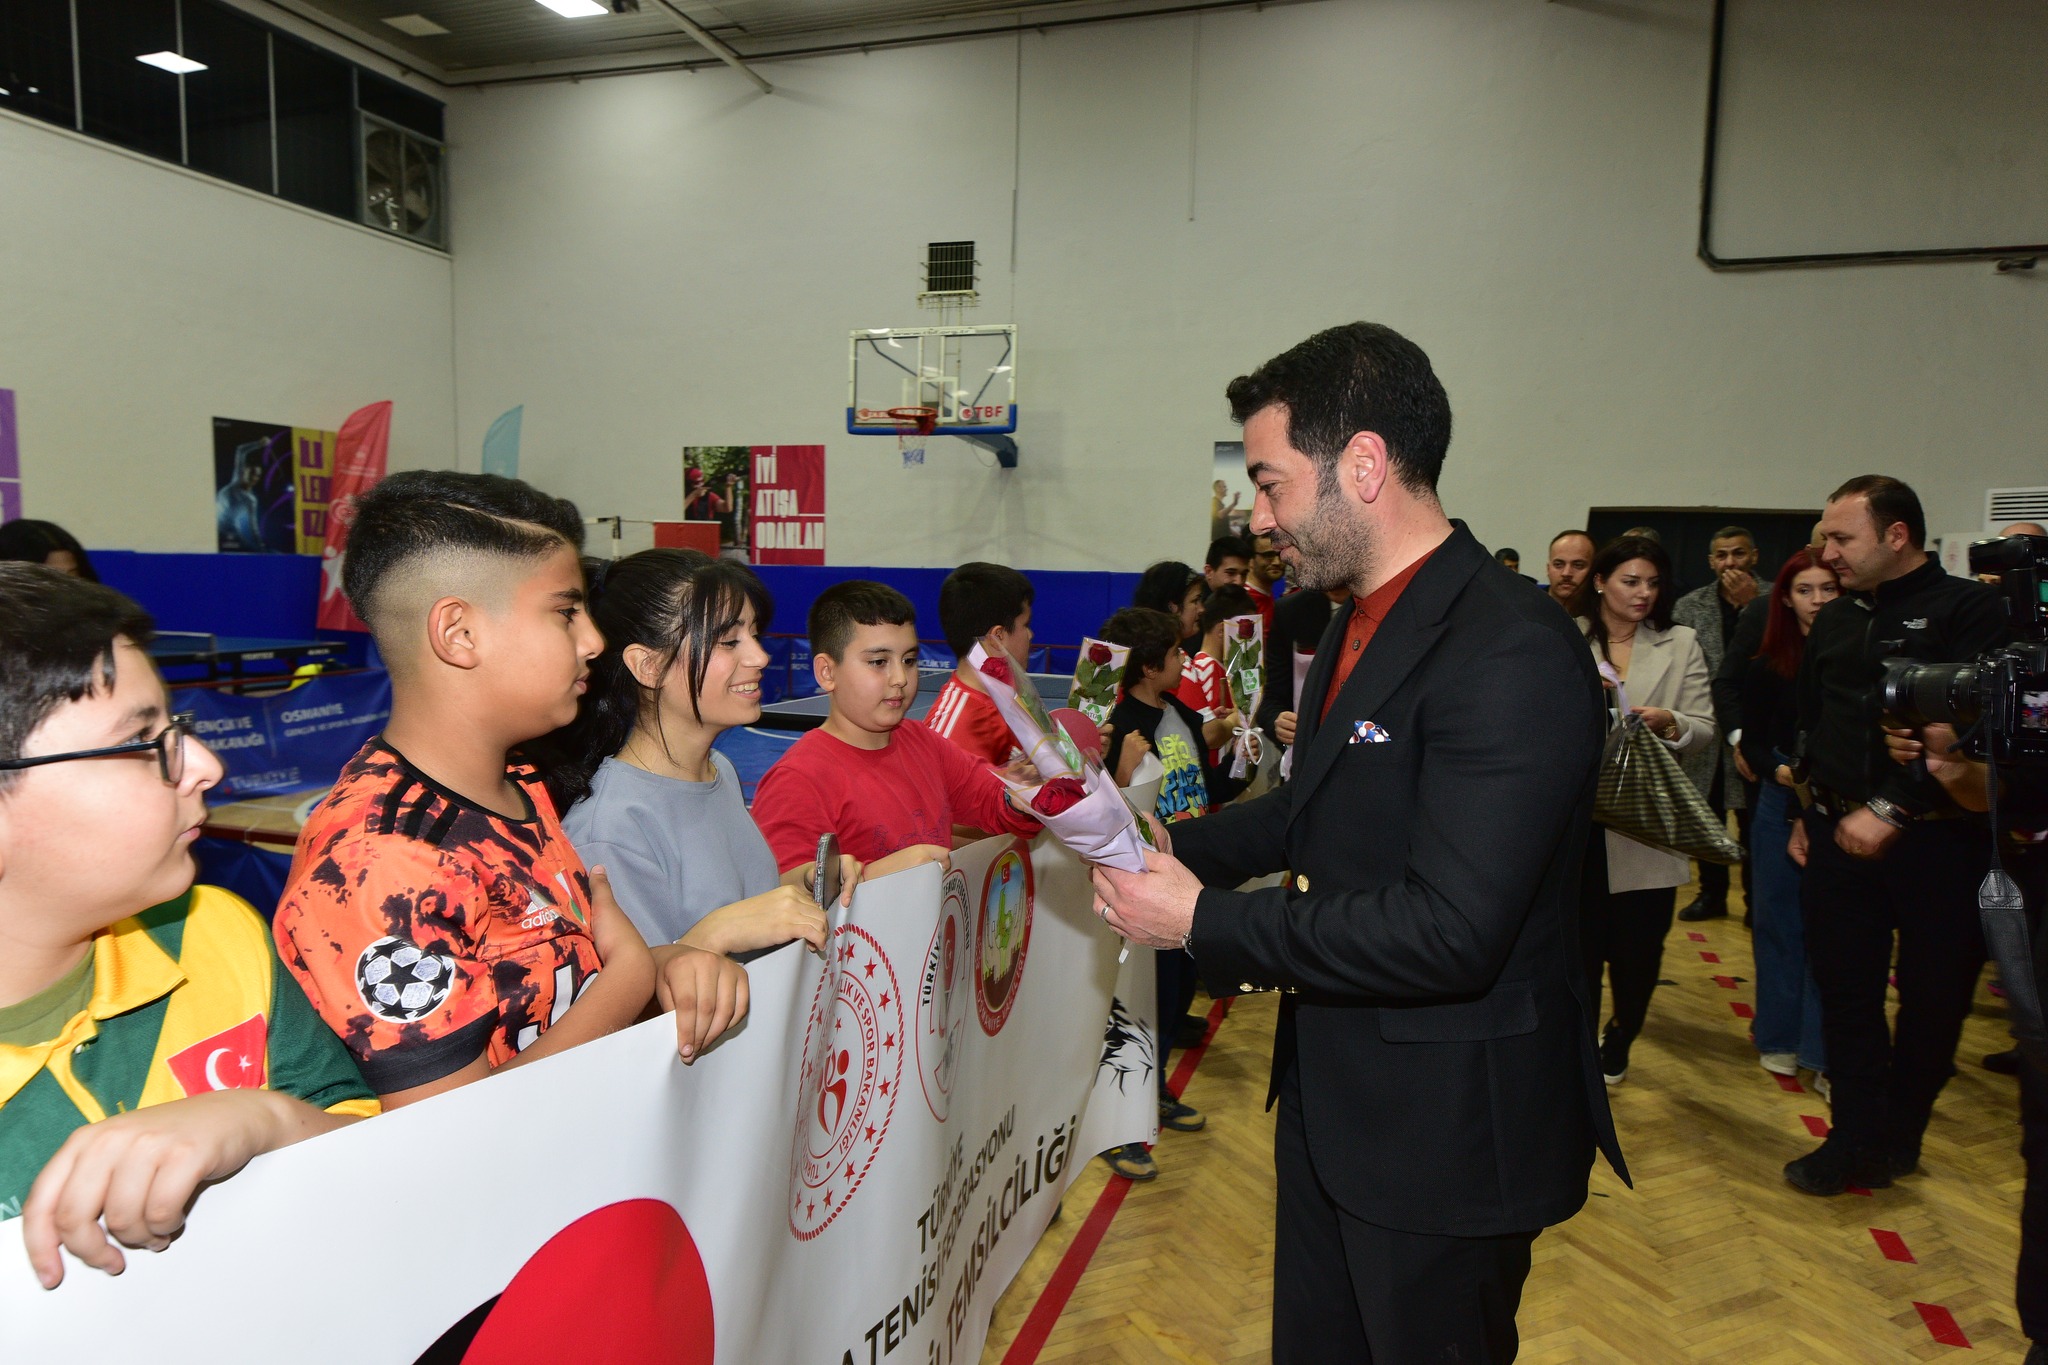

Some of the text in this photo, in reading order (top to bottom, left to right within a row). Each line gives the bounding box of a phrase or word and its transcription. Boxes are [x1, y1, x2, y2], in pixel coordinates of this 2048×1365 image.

[975, 406, 1004, 419] TBF
[755, 454, 777, 484] İYİ
[755, 489, 799, 518] ATIŞA
[755, 522, 824, 549] ODAKLAN
[839, 988, 875, 1155] VE SPOR BAKANLIĞI
[946, 1114, 1077, 1365] TEMSİLCİLİĞİ
